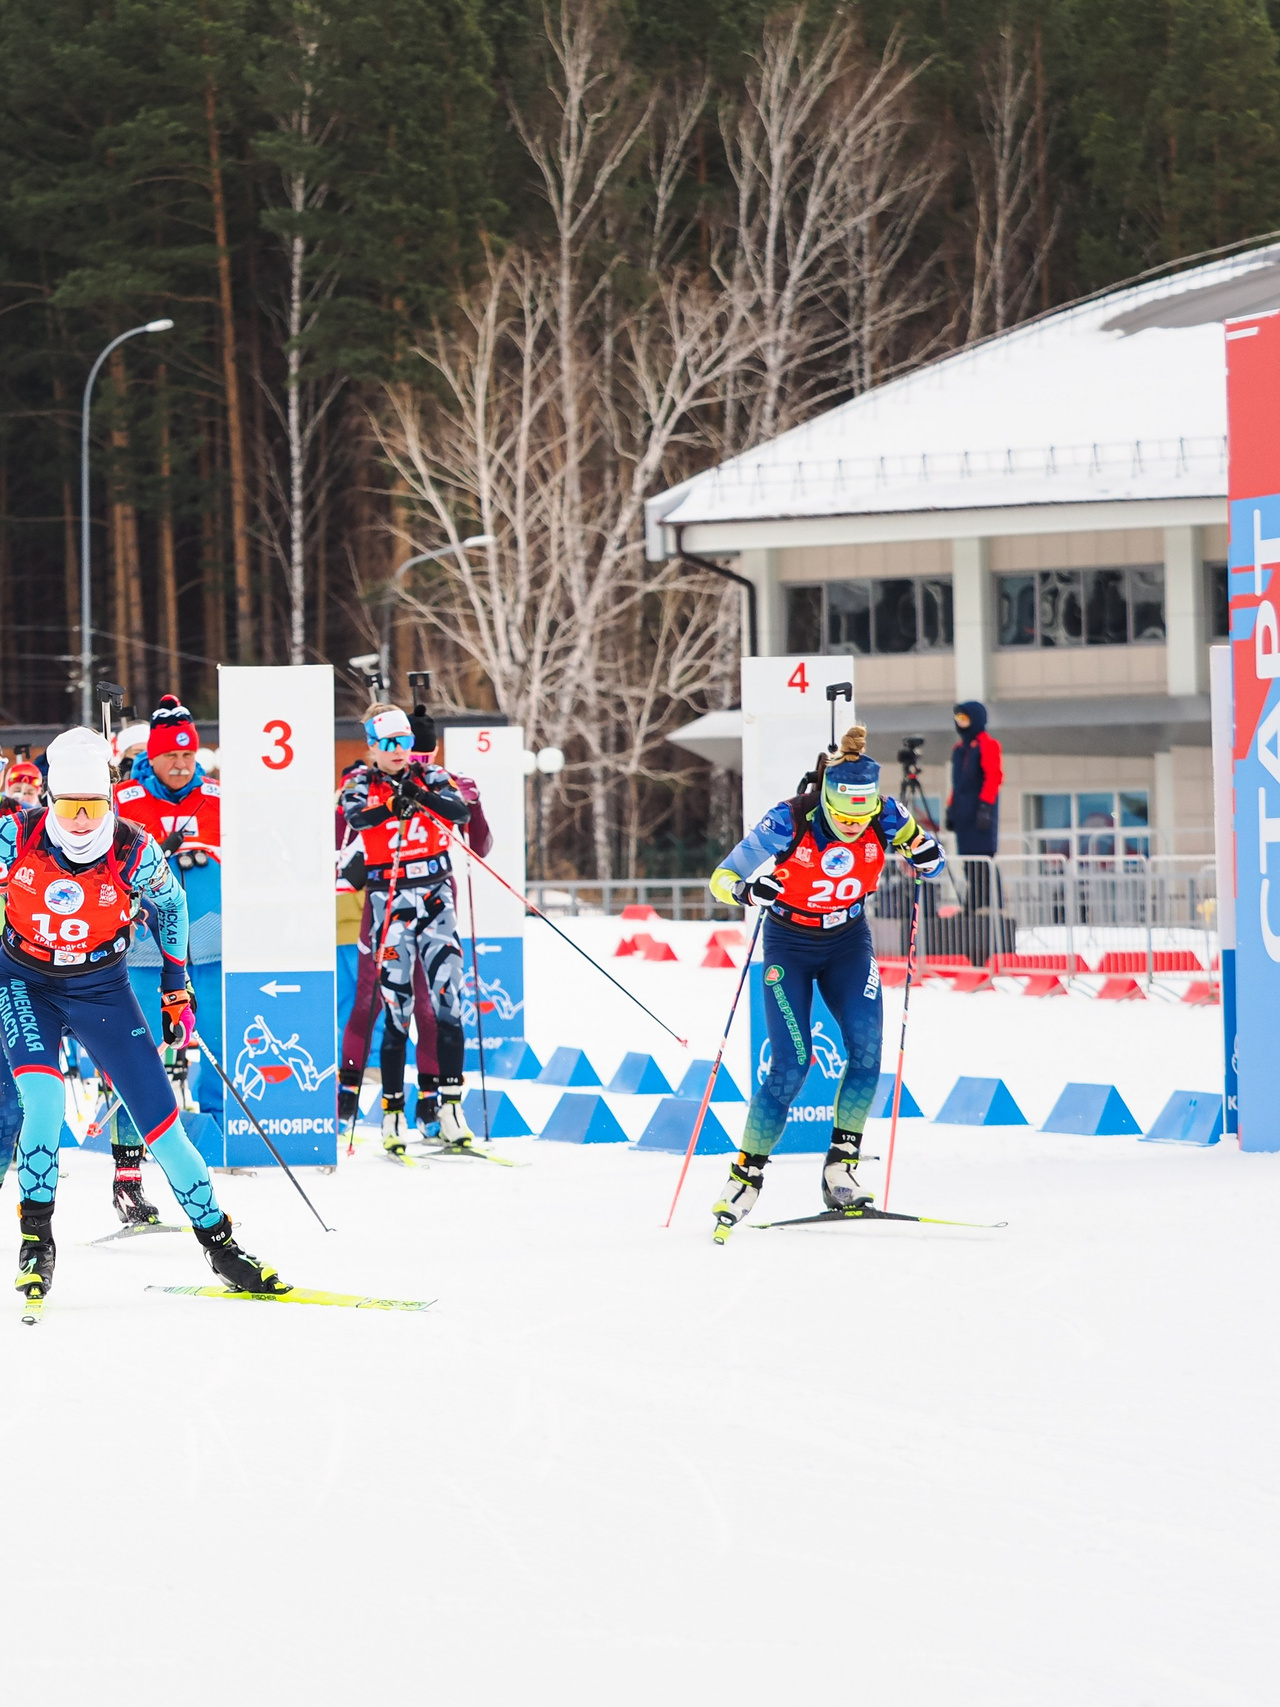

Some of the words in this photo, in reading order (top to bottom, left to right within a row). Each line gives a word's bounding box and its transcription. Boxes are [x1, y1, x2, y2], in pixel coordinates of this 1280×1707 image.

[787, 662, 810, 694] 4
[261, 719, 295, 770] 3
[476, 732, 492, 753] 5
[123, 789, 139, 800] 35
[385, 817, 428, 850] 24
[807, 878, 862, 902] 20
[31, 913, 90, 942] 18
[227, 1118, 335, 1136] КРАСНОЯРСК
[841, 1134, 857, 1142] 170
[210, 1231, 226, 1243] 168
[251, 1293, 277, 1301] FISCHER
